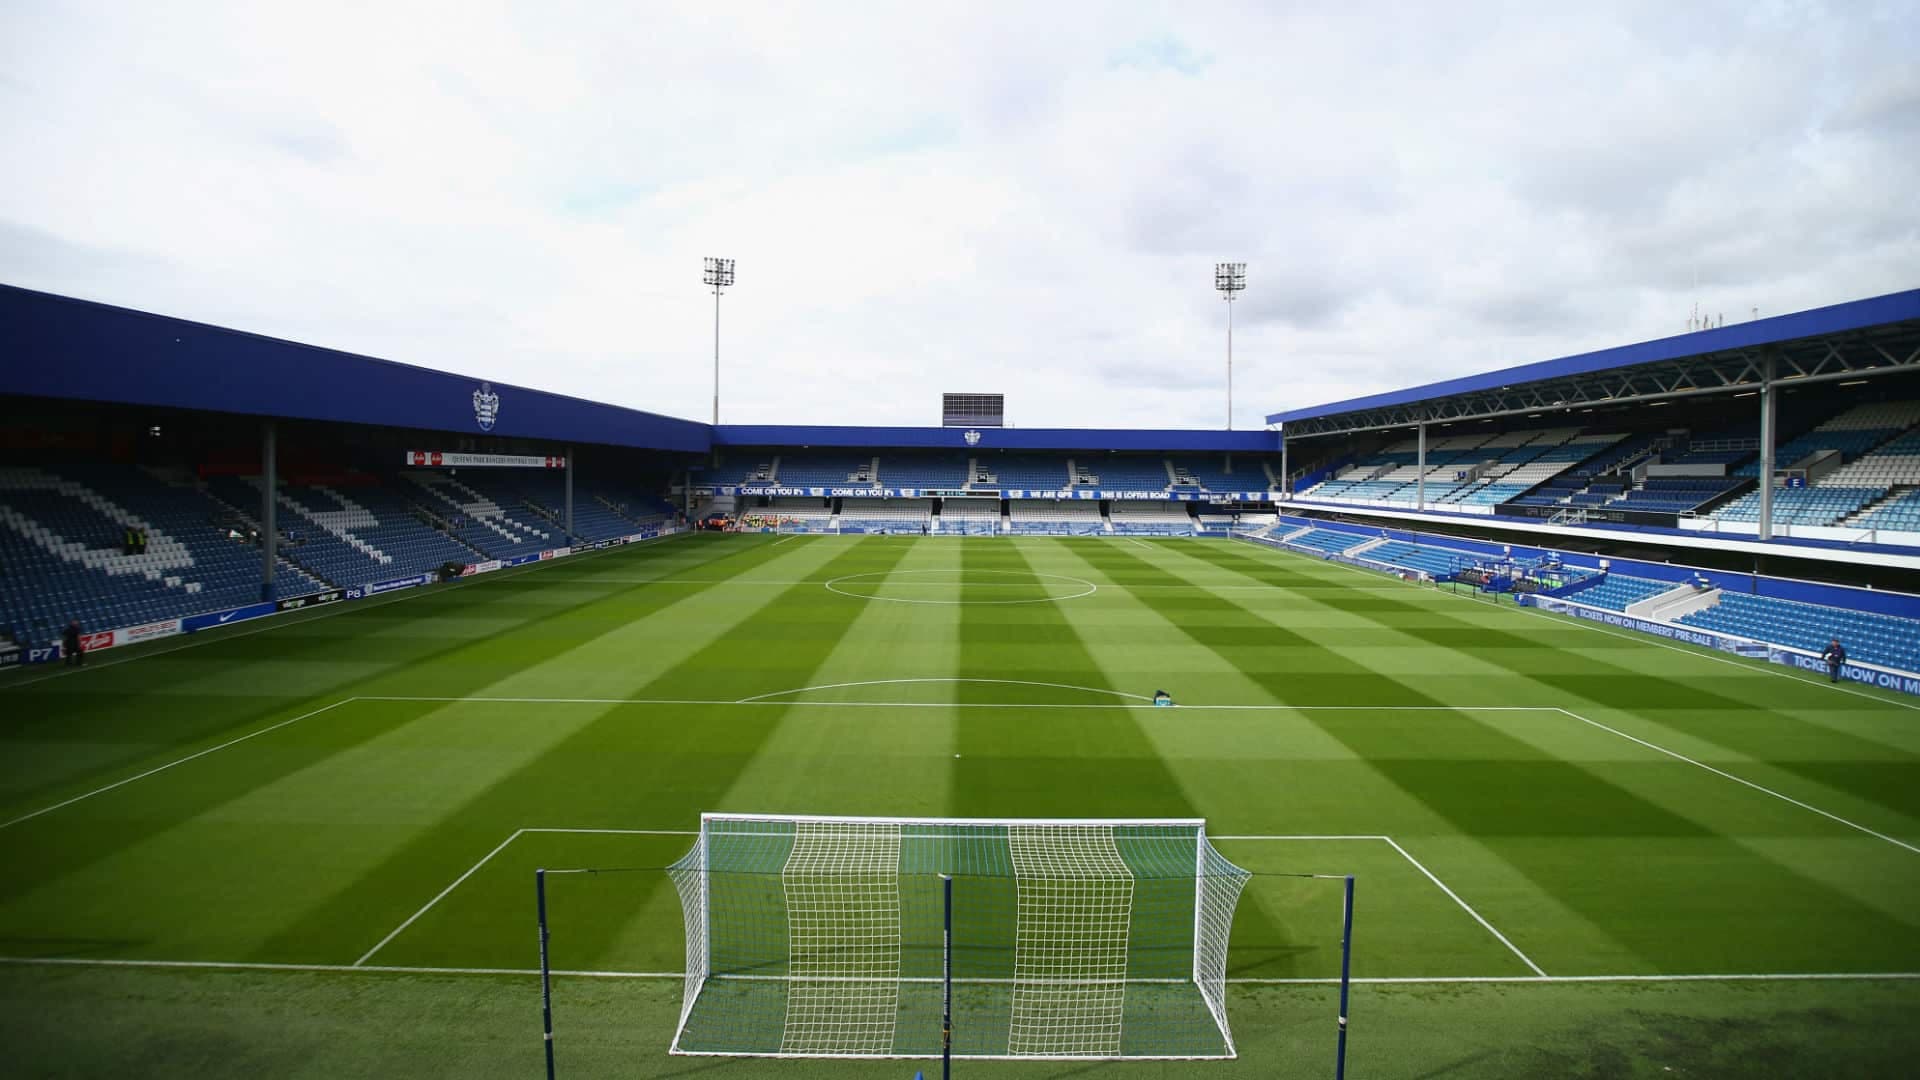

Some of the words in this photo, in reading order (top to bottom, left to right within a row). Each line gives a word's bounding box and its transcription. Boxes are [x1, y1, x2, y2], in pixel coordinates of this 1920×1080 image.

[741, 487, 763, 495] COME
[764, 487, 777, 495] ON
[777, 487, 792, 495] YOU
[831, 487, 853, 496] COME
[855, 488, 867, 496] ON
[868, 488, 883, 496] YOU
[346, 590, 361, 599] P8
[1579, 608, 1603, 622] TICKETS
[1604, 613, 1622, 626] NOW
[1622, 617, 1635, 628] ON
[1636, 621, 1673, 638] MEMBERS'
[1675, 629, 1712, 646] PRE-SALE
[29, 649, 54, 662] P7
[1794, 655, 1831, 673] TICKET
[1841, 667, 1876, 683] NOW
[1878, 674, 1901, 690] ON
